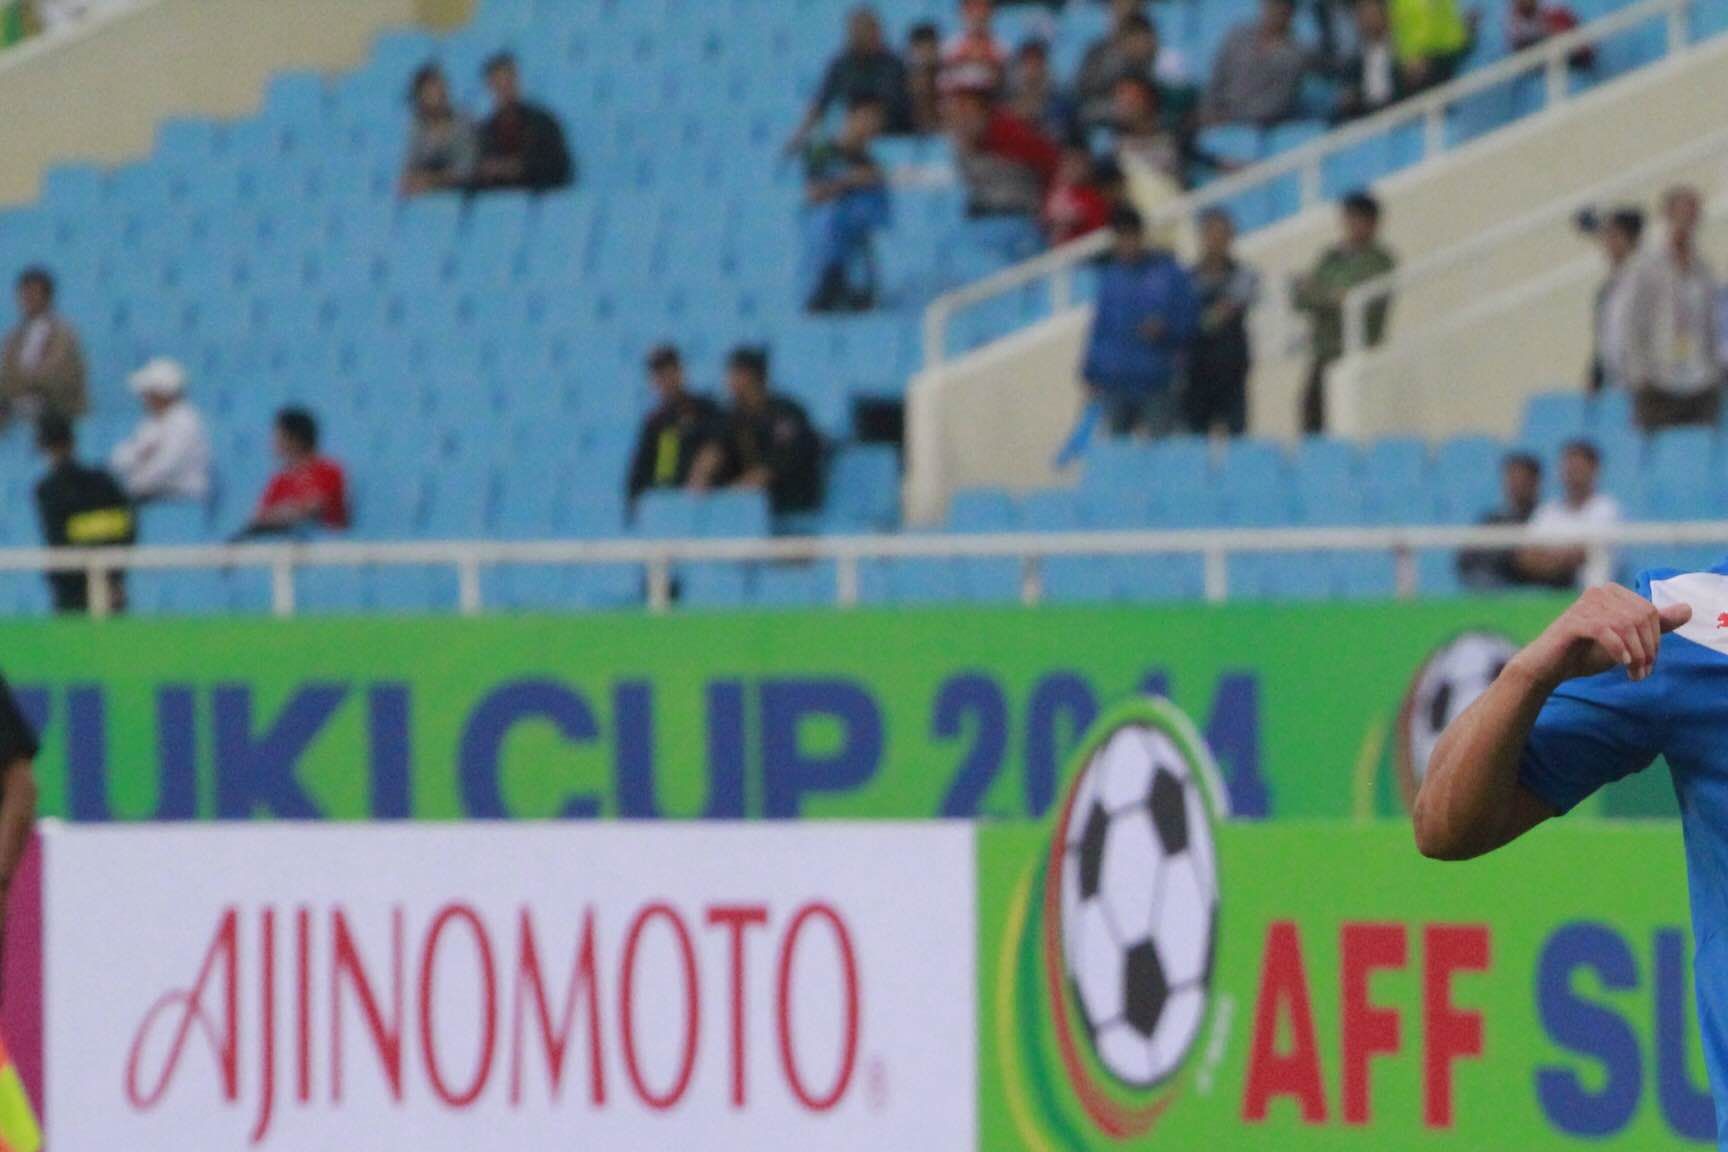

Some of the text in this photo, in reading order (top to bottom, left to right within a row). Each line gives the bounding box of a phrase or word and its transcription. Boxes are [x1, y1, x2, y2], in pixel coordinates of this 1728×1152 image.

[455, 678, 885, 821] CUP
[931, 667, 1272, 820] 204
[125, 902, 861, 1146] AJINOMOTO
[1240, 919, 1494, 1129] AFF
